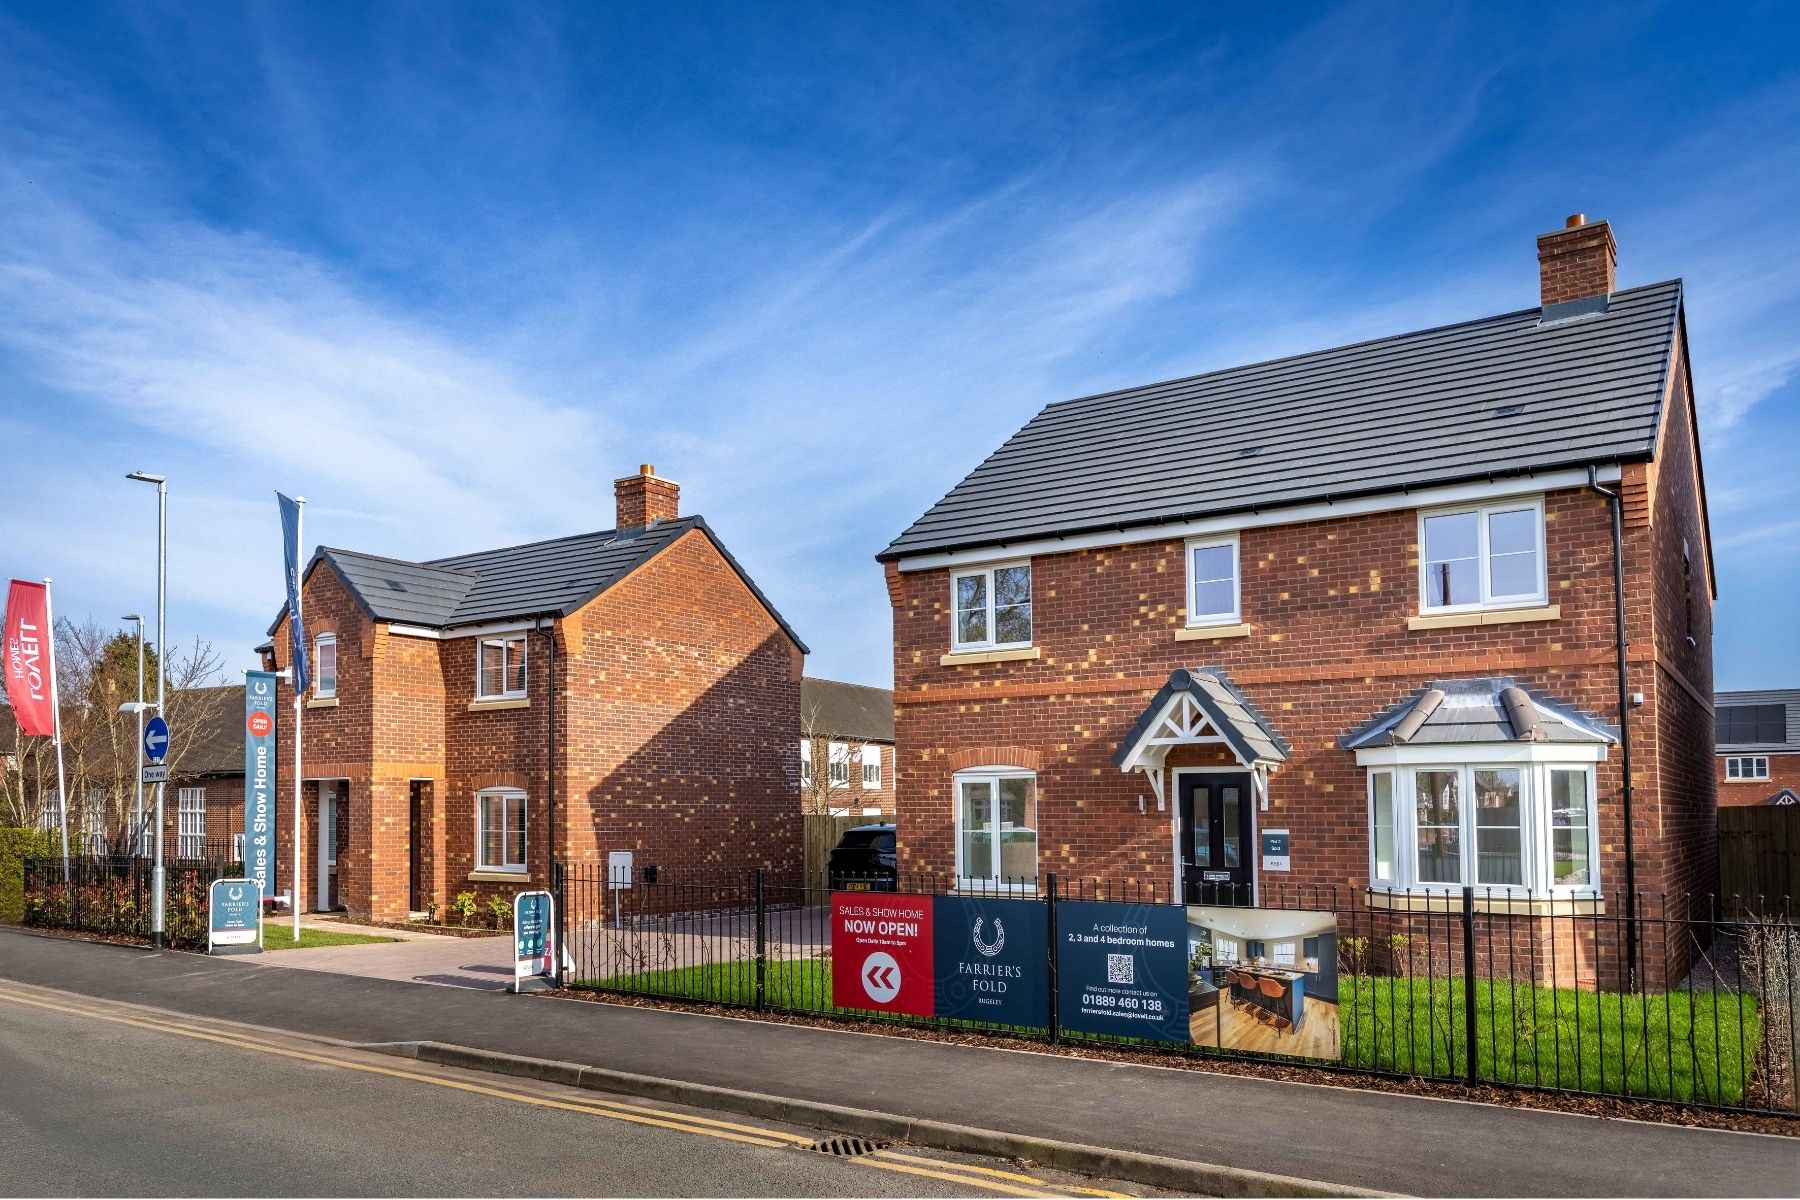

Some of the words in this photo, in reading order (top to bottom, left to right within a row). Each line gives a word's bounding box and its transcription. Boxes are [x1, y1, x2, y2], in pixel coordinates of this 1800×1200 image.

[254, 746, 267, 788] Home
[254, 792, 267, 832] Show
[254, 836, 267, 845] &
[840, 906, 864, 916] SALES
[866, 908, 871, 916] &
[873, 908, 897, 918] SHOW
[899, 909, 924, 919] HOME
[845, 920, 876, 933] NOW
[879, 922, 918, 937] OPEN!
[1093, 923, 1099, 932] A
[1100, 924, 1138, 934] collection
[1139, 926, 1148, 934] of
[1068, 933, 1075, 942] 2,
[1084, 934, 1098, 943] and
[1107, 936, 1144, 946] bedroom
[1146, 938, 1175, 948] homes
[959, 962, 1021, 978] FARRIER'S
[973, 980, 1007, 993] FOLD
[1082, 994, 1115, 1007] 01889
[1118, 998, 1138, 1009] 460
[1141, 999, 1162, 1011] 138
